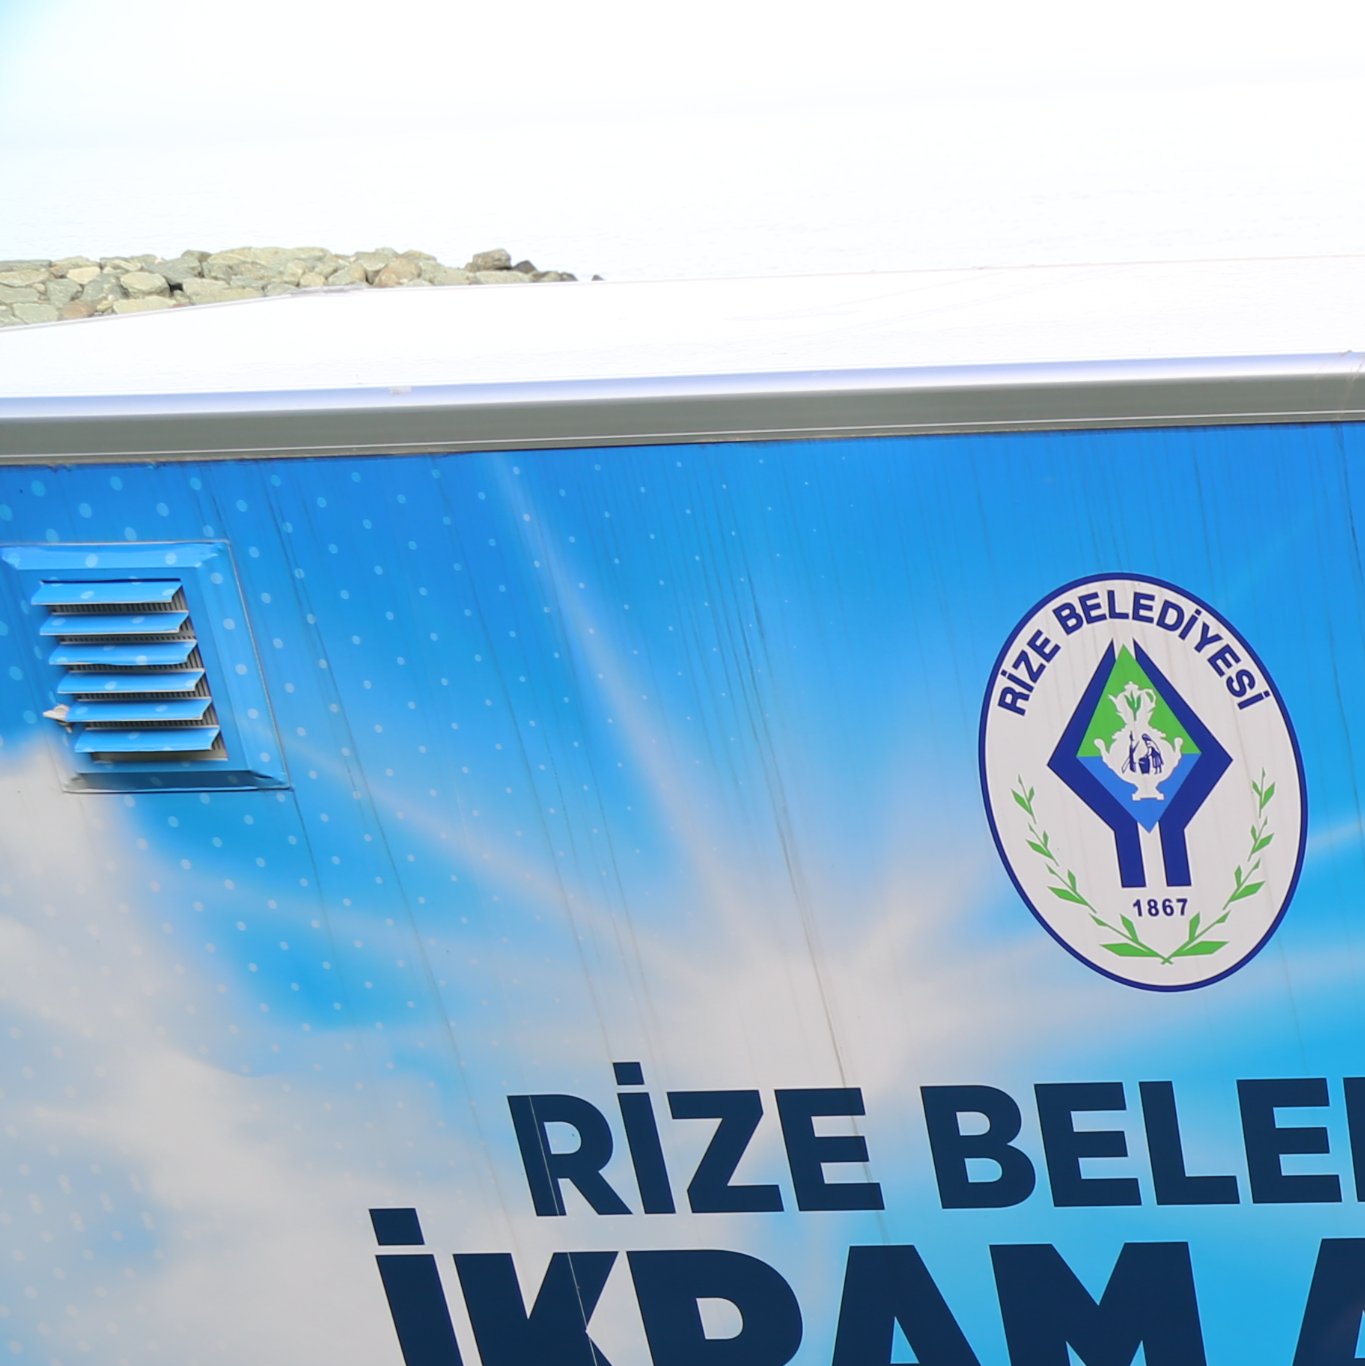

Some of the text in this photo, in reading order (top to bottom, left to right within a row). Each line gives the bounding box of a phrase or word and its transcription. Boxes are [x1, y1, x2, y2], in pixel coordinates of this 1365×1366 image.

[997, 589, 1271, 716] RİZE BELEDİYESİ
[1133, 899, 1188, 917] 1867
[507, 1062, 885, 1217] RİZE
